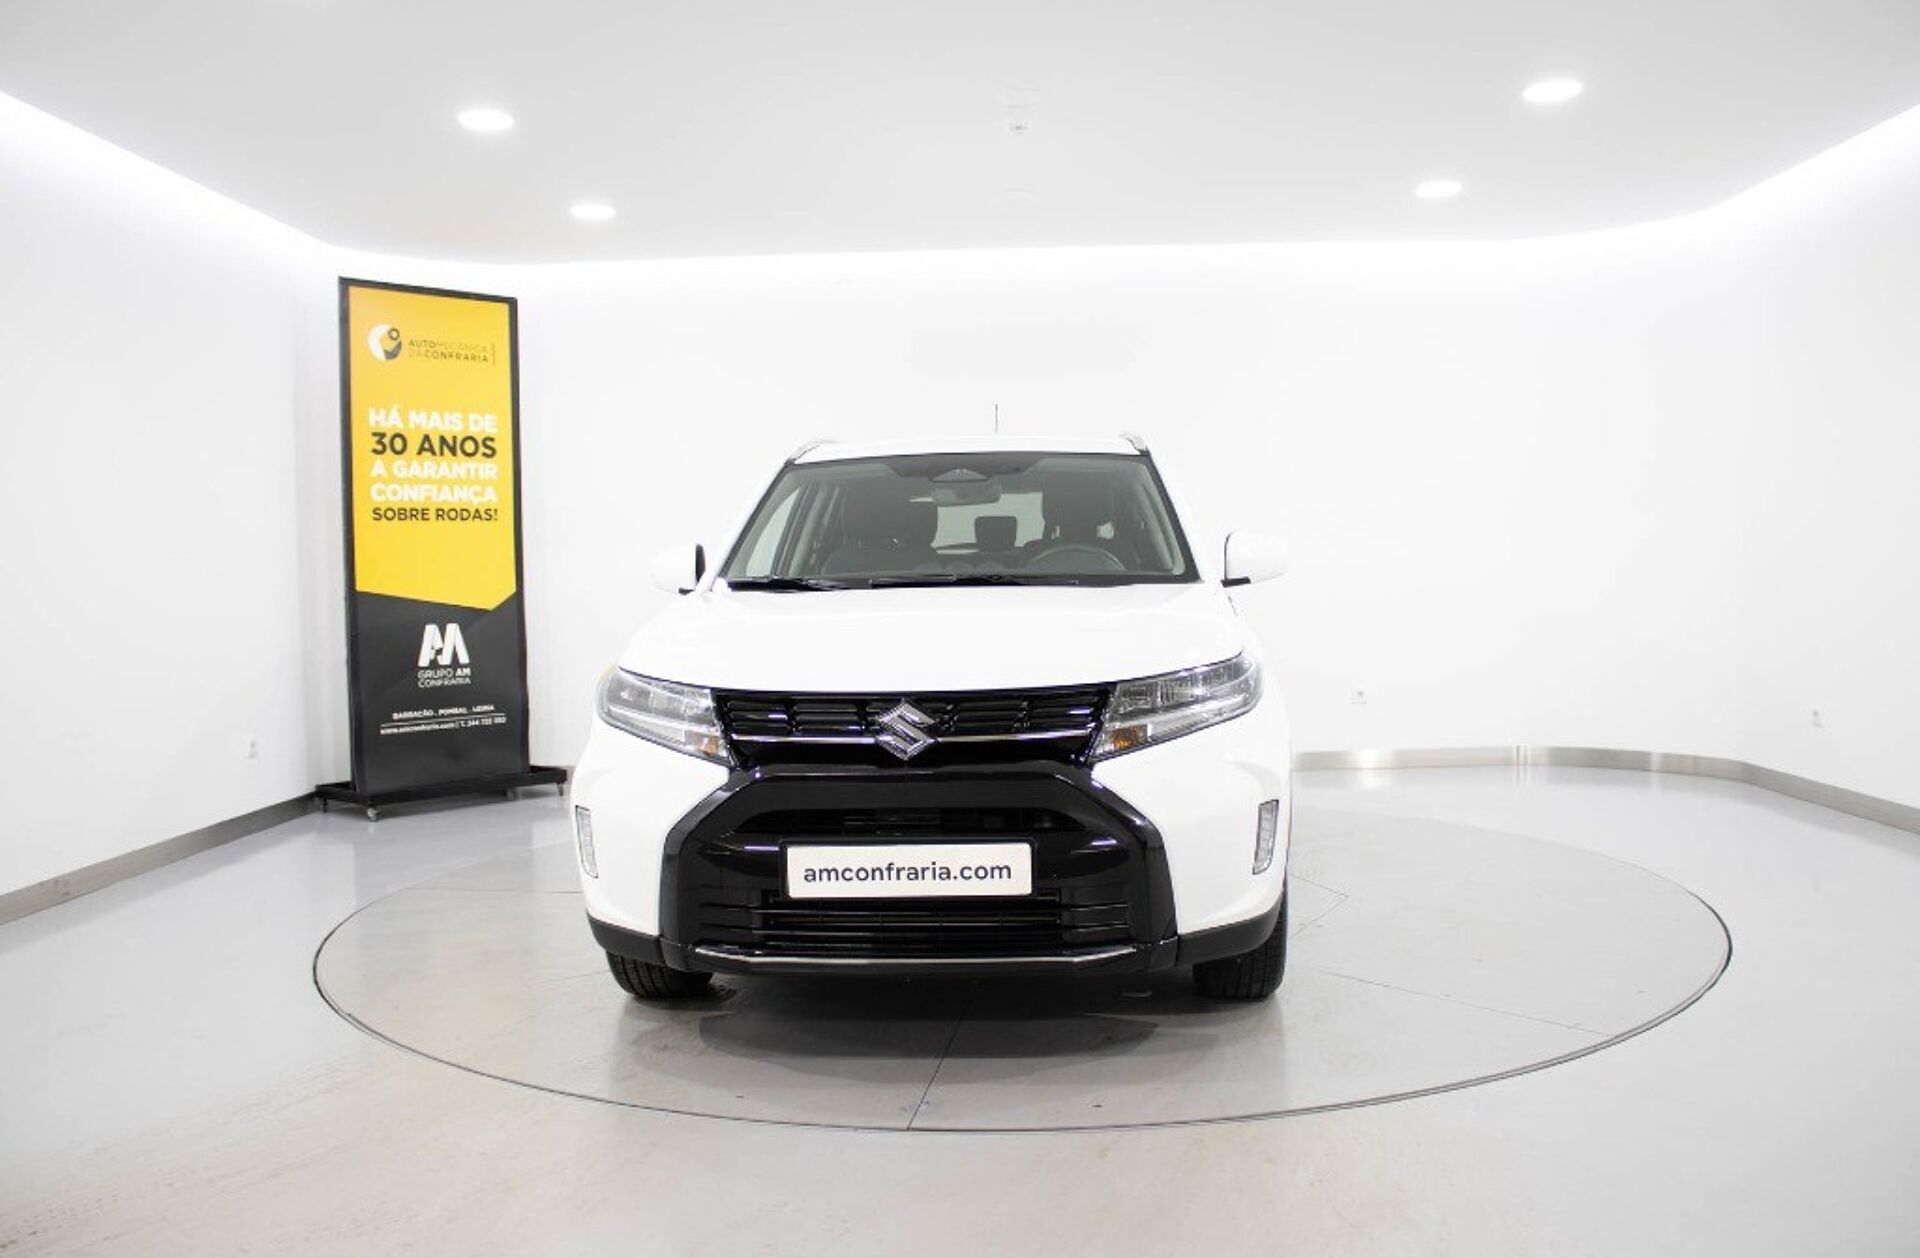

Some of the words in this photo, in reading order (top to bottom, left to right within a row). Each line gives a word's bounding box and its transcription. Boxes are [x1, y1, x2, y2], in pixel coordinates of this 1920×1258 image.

[368, 403, 403, 429] HÁ
[408, 411, 464, 431] MAIS
[469, 413, 498, 433] DE
[371, 432, 408, 456] 30
[416, 433, 497, 459] ANOS
[370, 459, 387, 478] A
[392, 461, 498, 480] GARANTIR
[370, 483, 497, 505] CONFIANÇA
[372, 507, 430, 521] SOBRE
[435, 508, 498, 521] RODAS!
[418, 669, 453, 679] GRUPO
[455, 667, 471, 677] AM
[803, 861, 1012, 882] amconfraria.com
